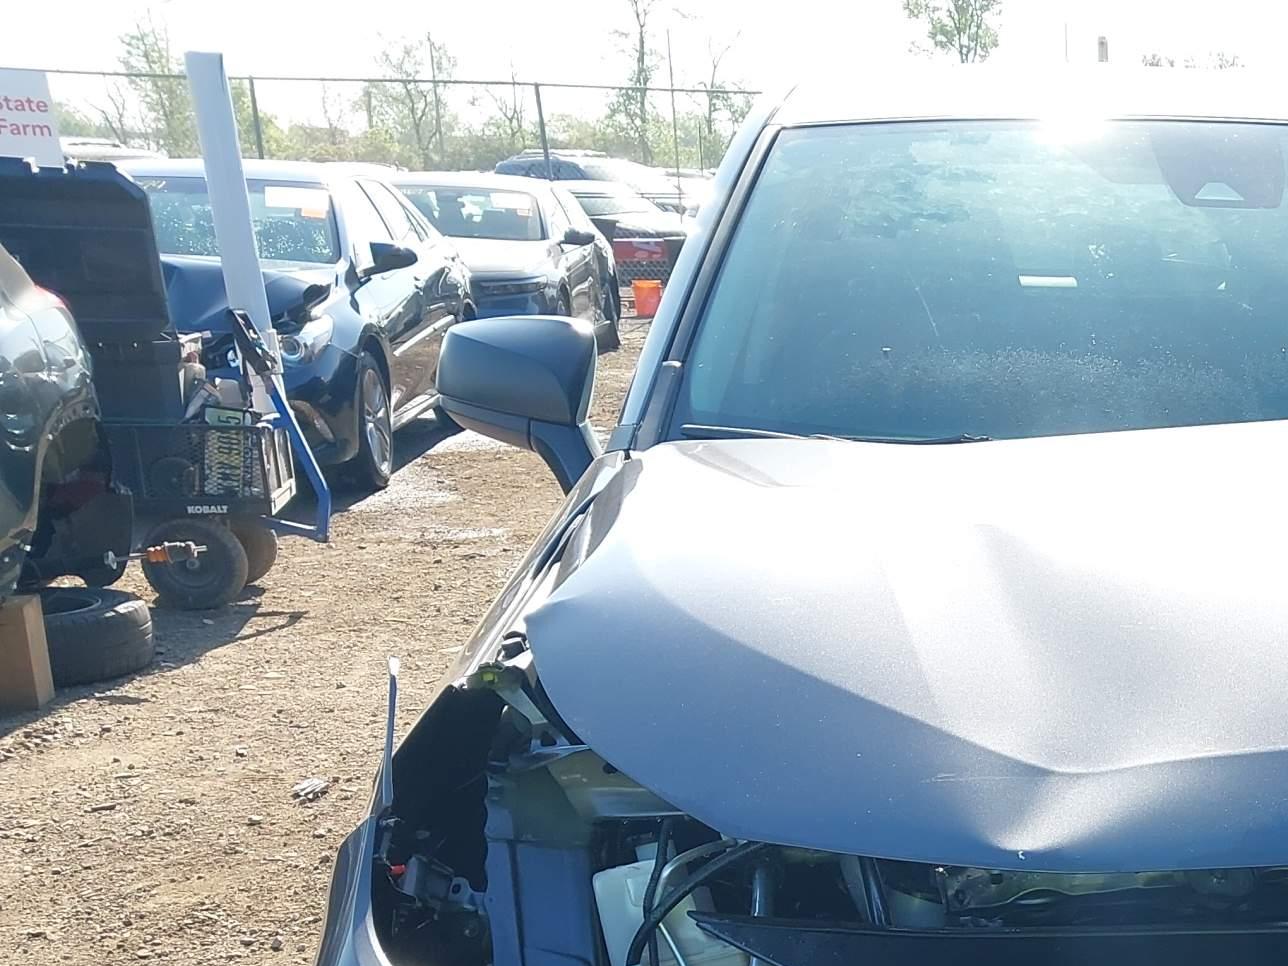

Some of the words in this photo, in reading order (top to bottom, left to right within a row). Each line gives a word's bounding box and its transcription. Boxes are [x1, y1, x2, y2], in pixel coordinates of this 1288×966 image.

[0, 95, 49, 113] tate
[0, 118, 52, 137] Farm
[186, 504, 229, 514] KOBALT
